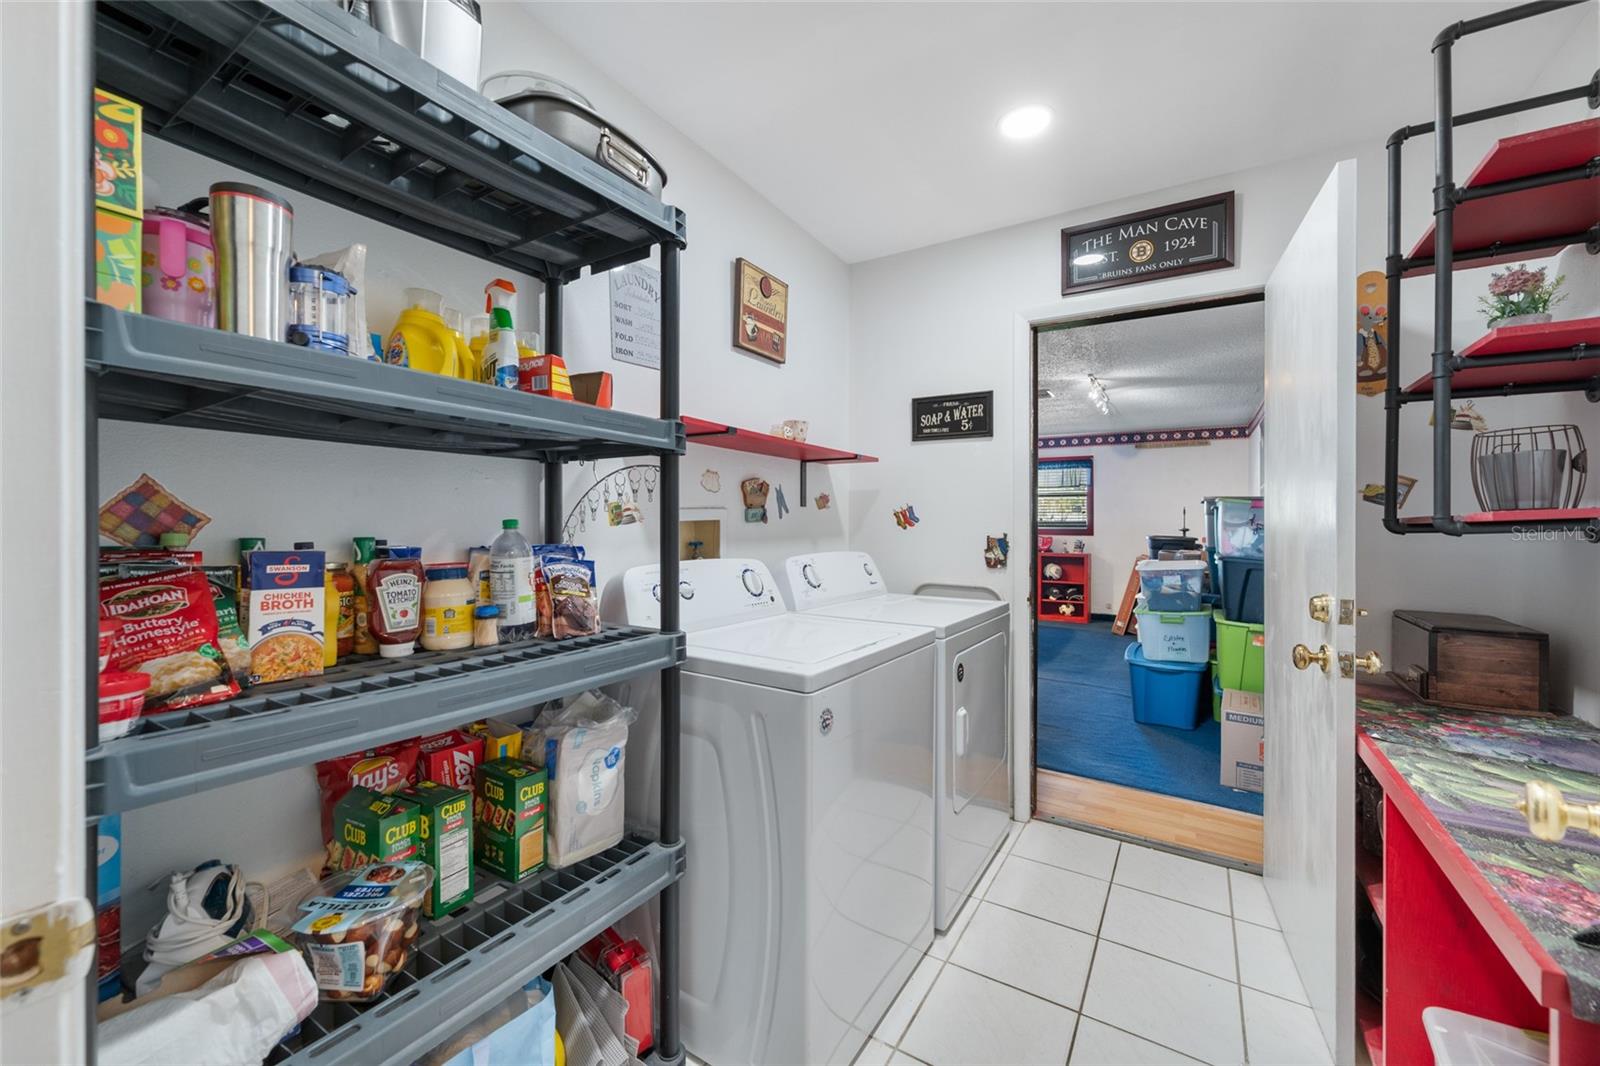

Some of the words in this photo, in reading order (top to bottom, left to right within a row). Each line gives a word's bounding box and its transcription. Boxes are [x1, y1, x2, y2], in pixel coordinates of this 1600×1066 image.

[1082, 232, 1113, 253] THE
[1118, 221, 1159, 241] MAN
[1164, 217, 1208, 231] CAVE
[1164, 236, 1196, 252] 1924
[1102, 268, 1133, 279] BRUINS
[1135, 263, 1157, 273] FANS
[1159, 258, 1184, 268] ONLY
[614, 273, 660, 303] LAUNDRY
[614, 301, 632, 312] SORT
[615, 316, 633, 327] WASH
[615, 331, 634, 342] FOLD
[615, 346, 634, 357] IRON
[920, 412, 943, 427] SOAP
[944, 410, 951, 422] &
[953, 403, 984, 420] WATER
[389, 579, 412, 587] HEINZ
[109, 590, 183, 616] IDAHOAN
[263, 592, 311, 601] CHICKEN
[386, 589, 417, 599] TOMATO
[388, 596, 417, 604] KETCHUP
[260, 599, 314, 611] BROTH
[123, 616, 184, 634] Buttery
[111, 643, 154, 659] MASHED
[157, 628, 206, 645] POTATOES
[112, 621, 200, 649] Homestyle
[484, 781, 504, 801] CLUB
[520, 782, 545, 802] CLUB
[441, 800, 466, 819] CLUB
[344, 823, 367, 846] CLUB
[385, 820, 416, 845] CLUB
[308, 900, 391, 911] PRETZILLA
